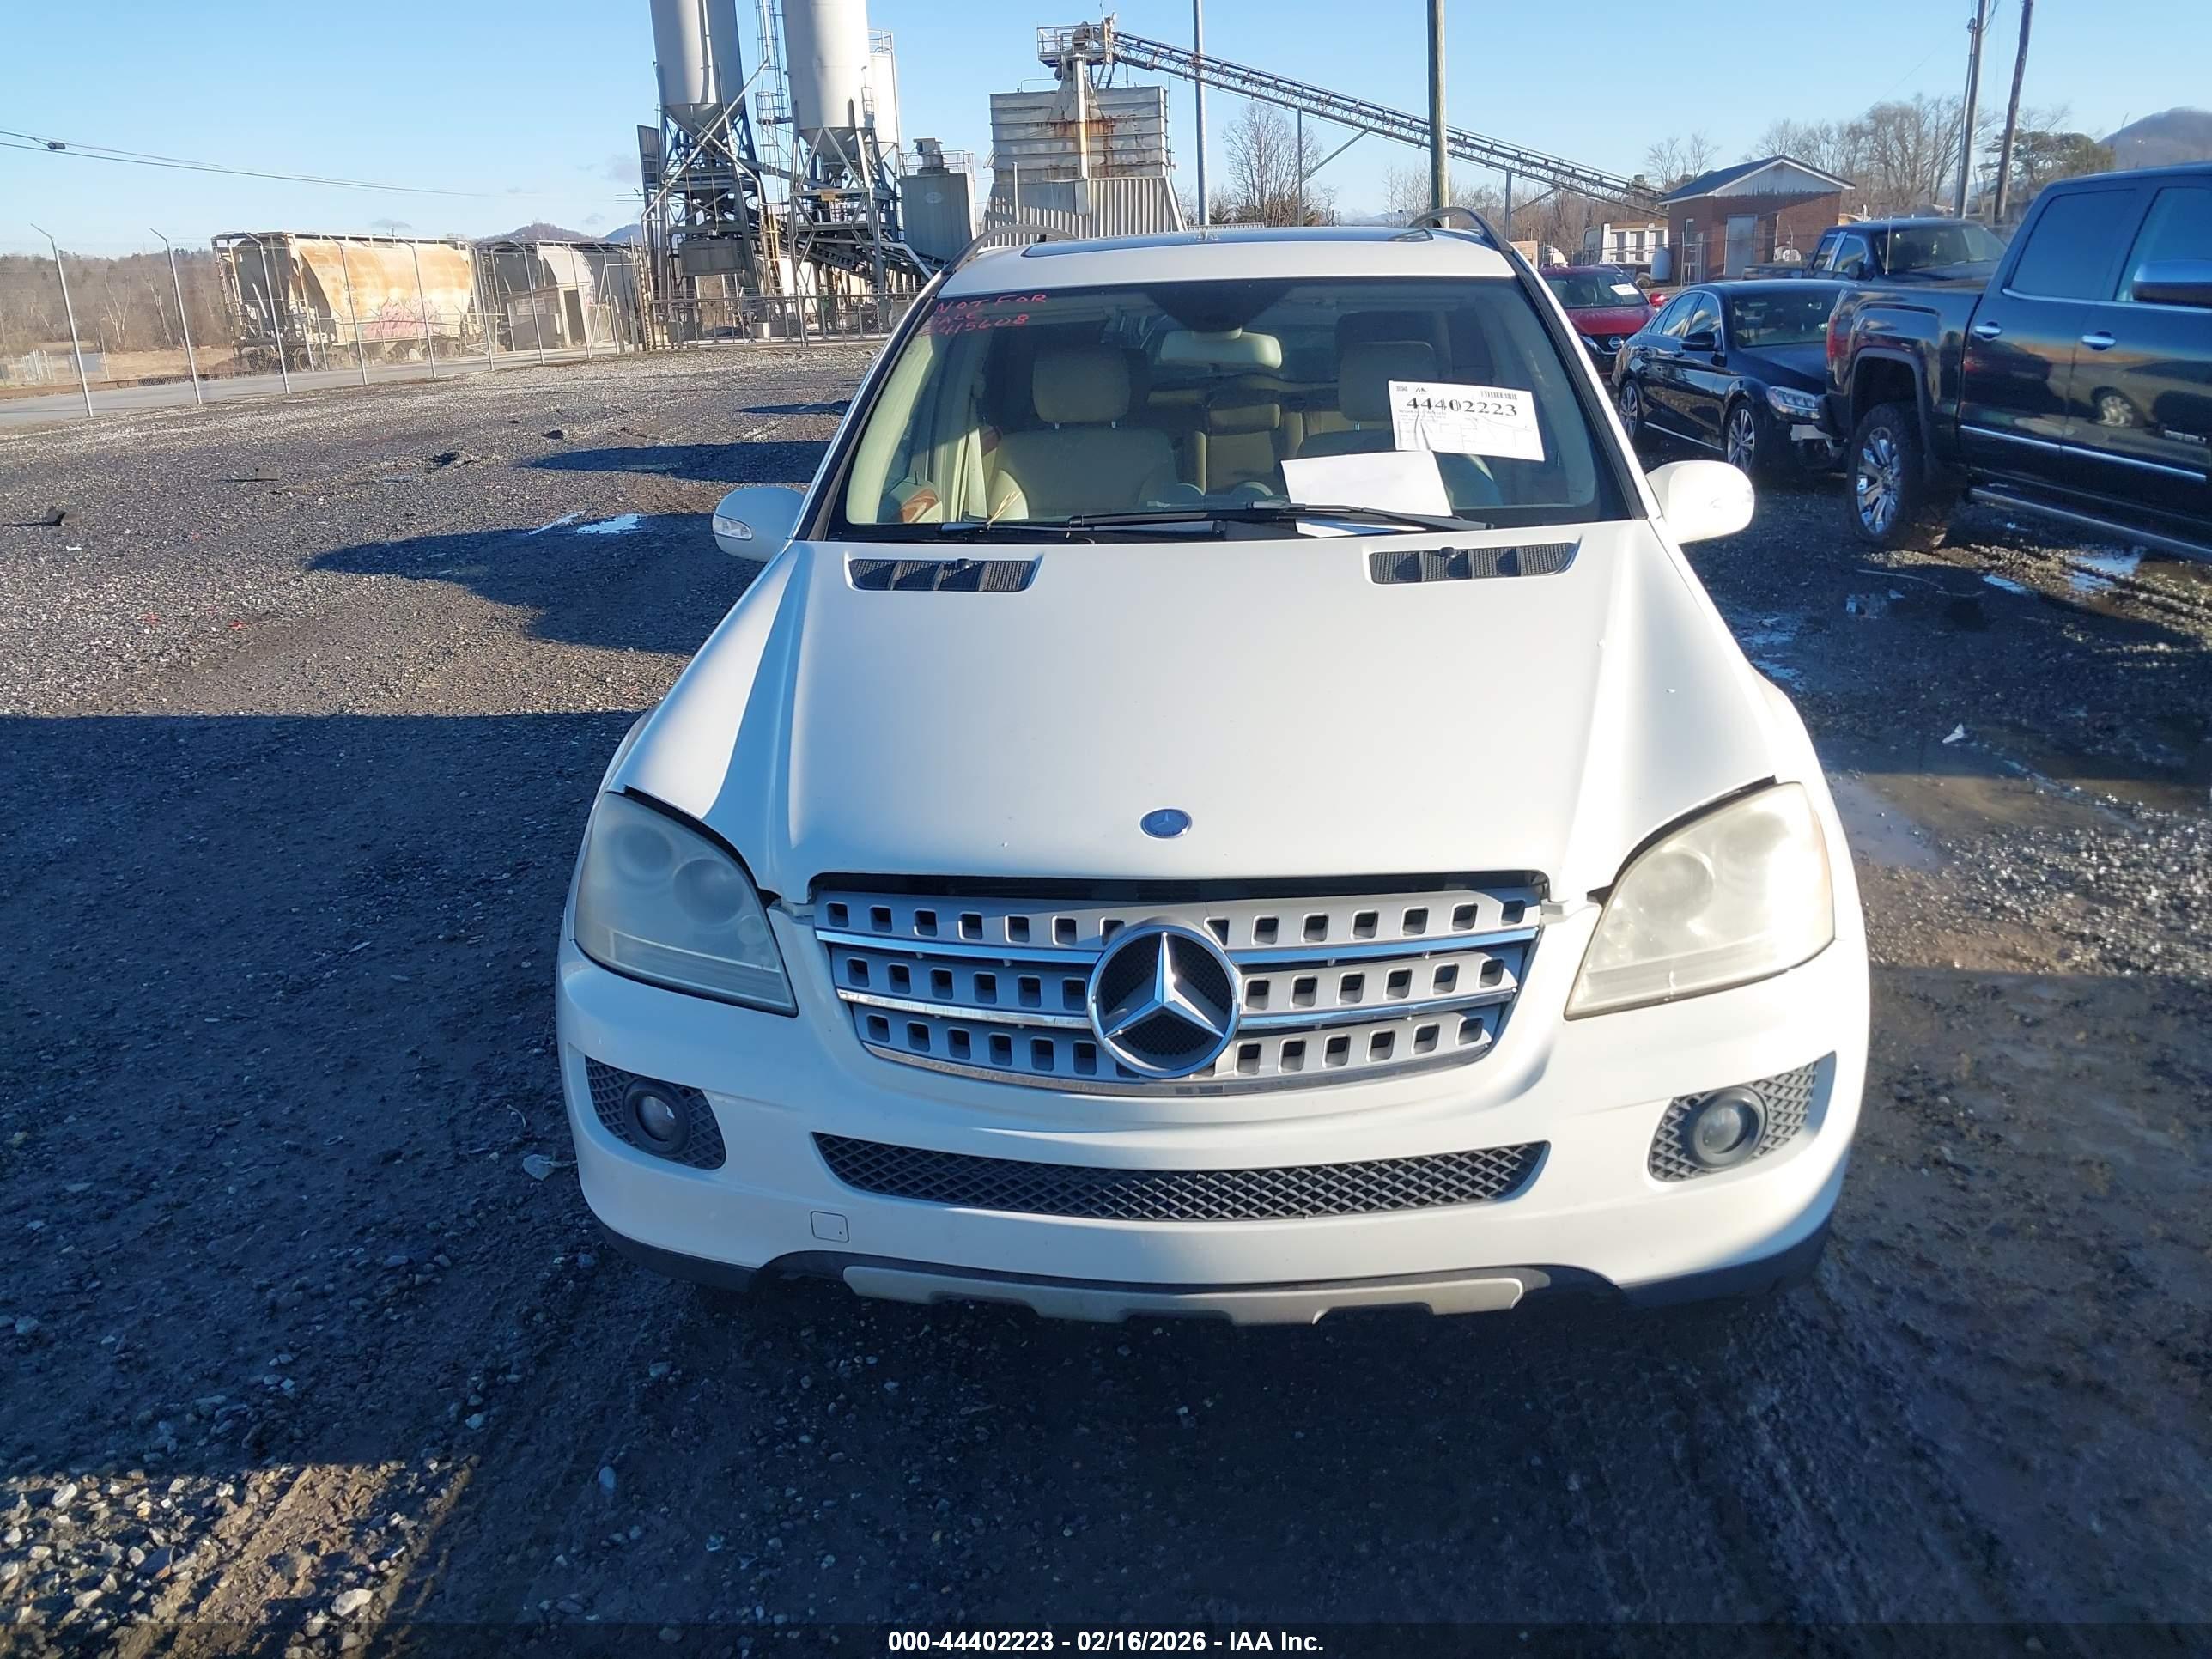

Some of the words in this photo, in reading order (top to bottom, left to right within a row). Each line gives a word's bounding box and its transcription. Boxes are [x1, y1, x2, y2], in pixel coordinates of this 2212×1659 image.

[936, 300, 988, 313] NOT
[994, 294, 1047, 306] FOR
[1407, 398, 1517, 416] 44402223
